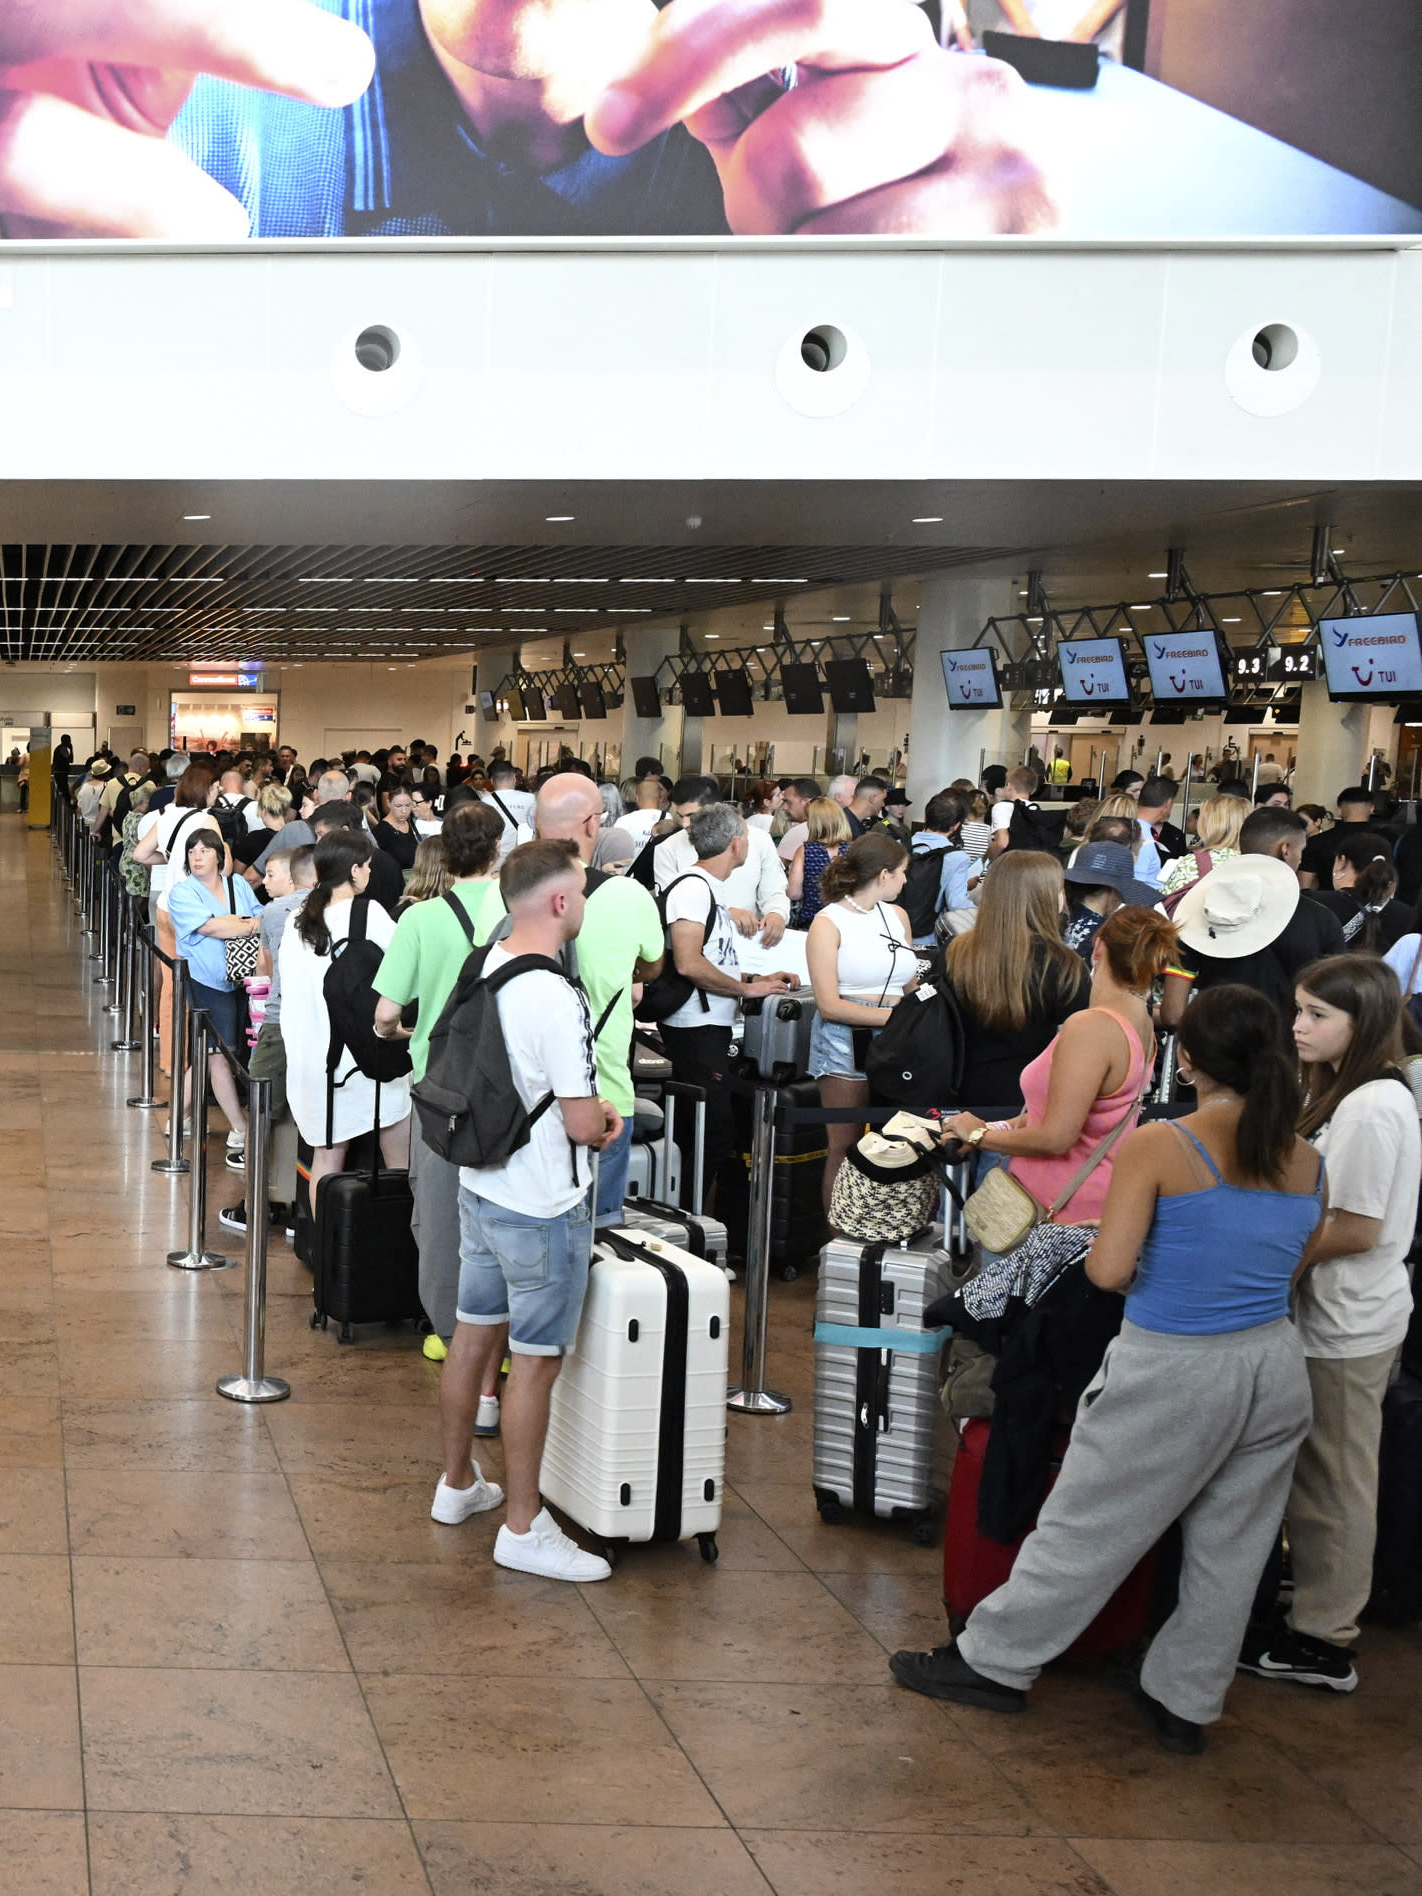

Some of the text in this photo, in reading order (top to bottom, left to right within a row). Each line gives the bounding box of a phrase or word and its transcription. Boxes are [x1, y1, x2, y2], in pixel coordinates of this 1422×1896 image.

[1348, 634, 1407, 647] FREEBIRD
[1165, 648, 1209, 659] FREEBIRD
[1076, 655, 1115, 665] FREEBIRD
[1284, 654, 1309, 672] 9.2
[1238, 657, 1260, 675] 9.3
[1377, 671, 1397, 683] TUI
[1097, 682, 1110, 693] TUI
[1188, 679, 1204, 690] TUI
